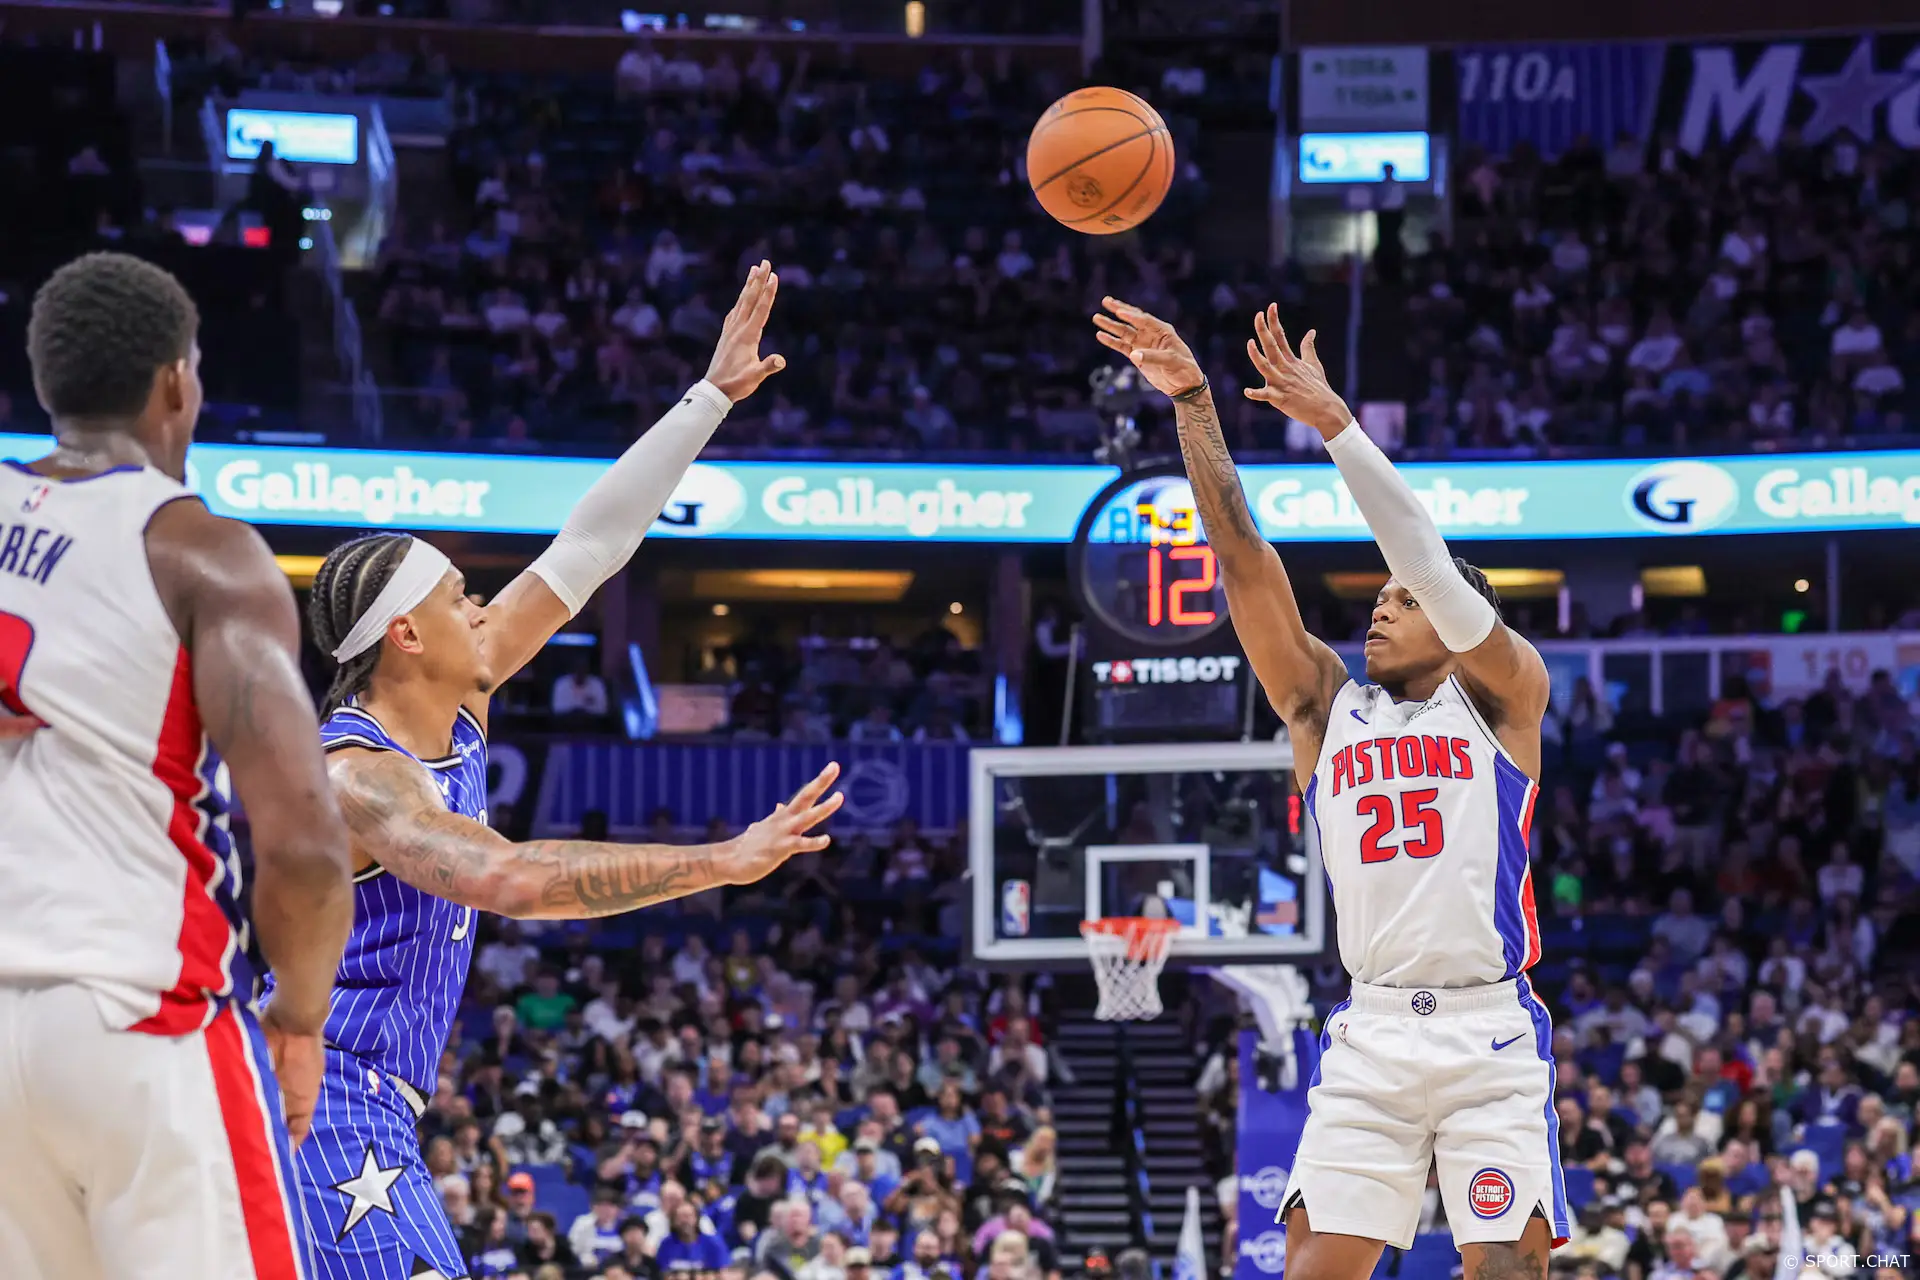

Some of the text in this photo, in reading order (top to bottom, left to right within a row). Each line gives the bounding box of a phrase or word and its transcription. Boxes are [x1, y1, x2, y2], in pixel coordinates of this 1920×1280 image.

[215, 459, 490, 524] Gallagher
[761, 475, 1033, 537] Gallagher
[0, 524, 74, 586] REN
[1147, 546, 1217, 626] 12
[1131, 655, 1241, 683] TISSOT
[1331, 734, 1474, 798] PISTONS
[1356, 787, 1445, 865] 25
[1475, 1185, 1505, 1194] DETROIT
[1475, 1194, 1505, 1203] PISTONS
